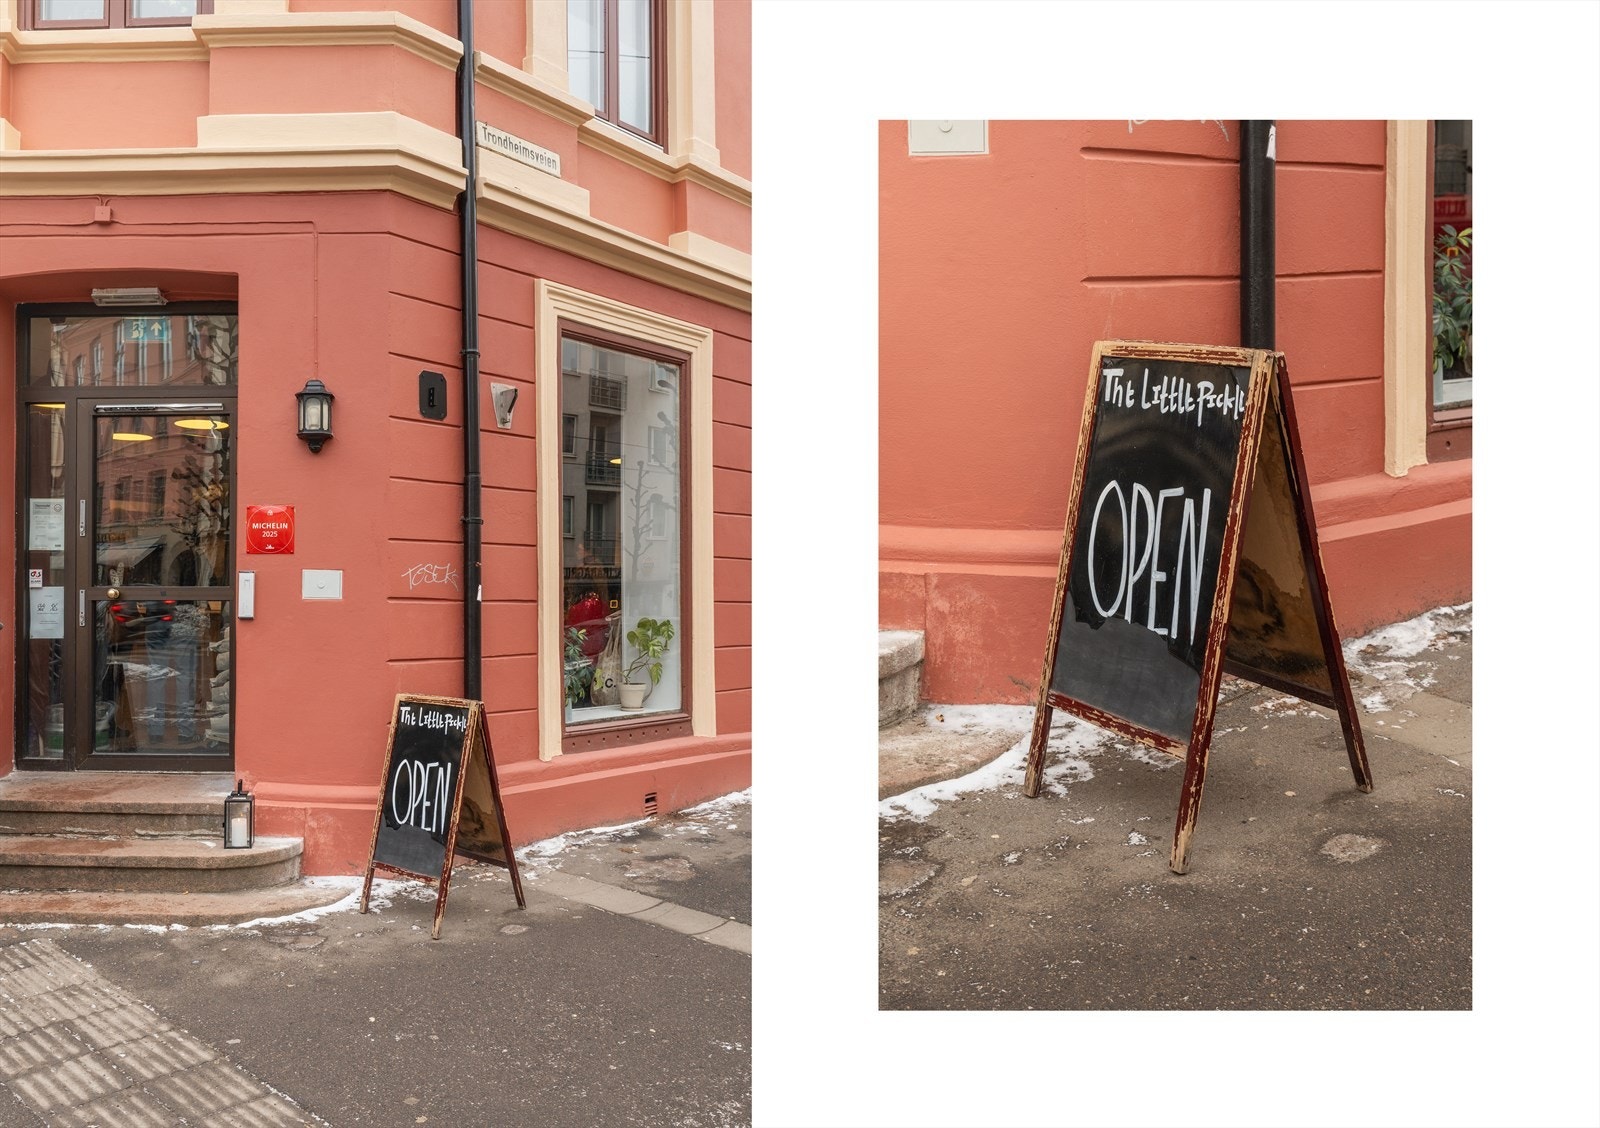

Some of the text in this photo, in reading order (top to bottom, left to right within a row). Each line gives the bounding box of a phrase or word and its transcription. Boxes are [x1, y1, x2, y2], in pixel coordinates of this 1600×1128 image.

[482, 126, 557, 170] Trondheimsveien
[262, 530, 278, 538] 2025
[1087, 479, 1211, 646] OPEN
[392, 758, 452, 835] OPEN
